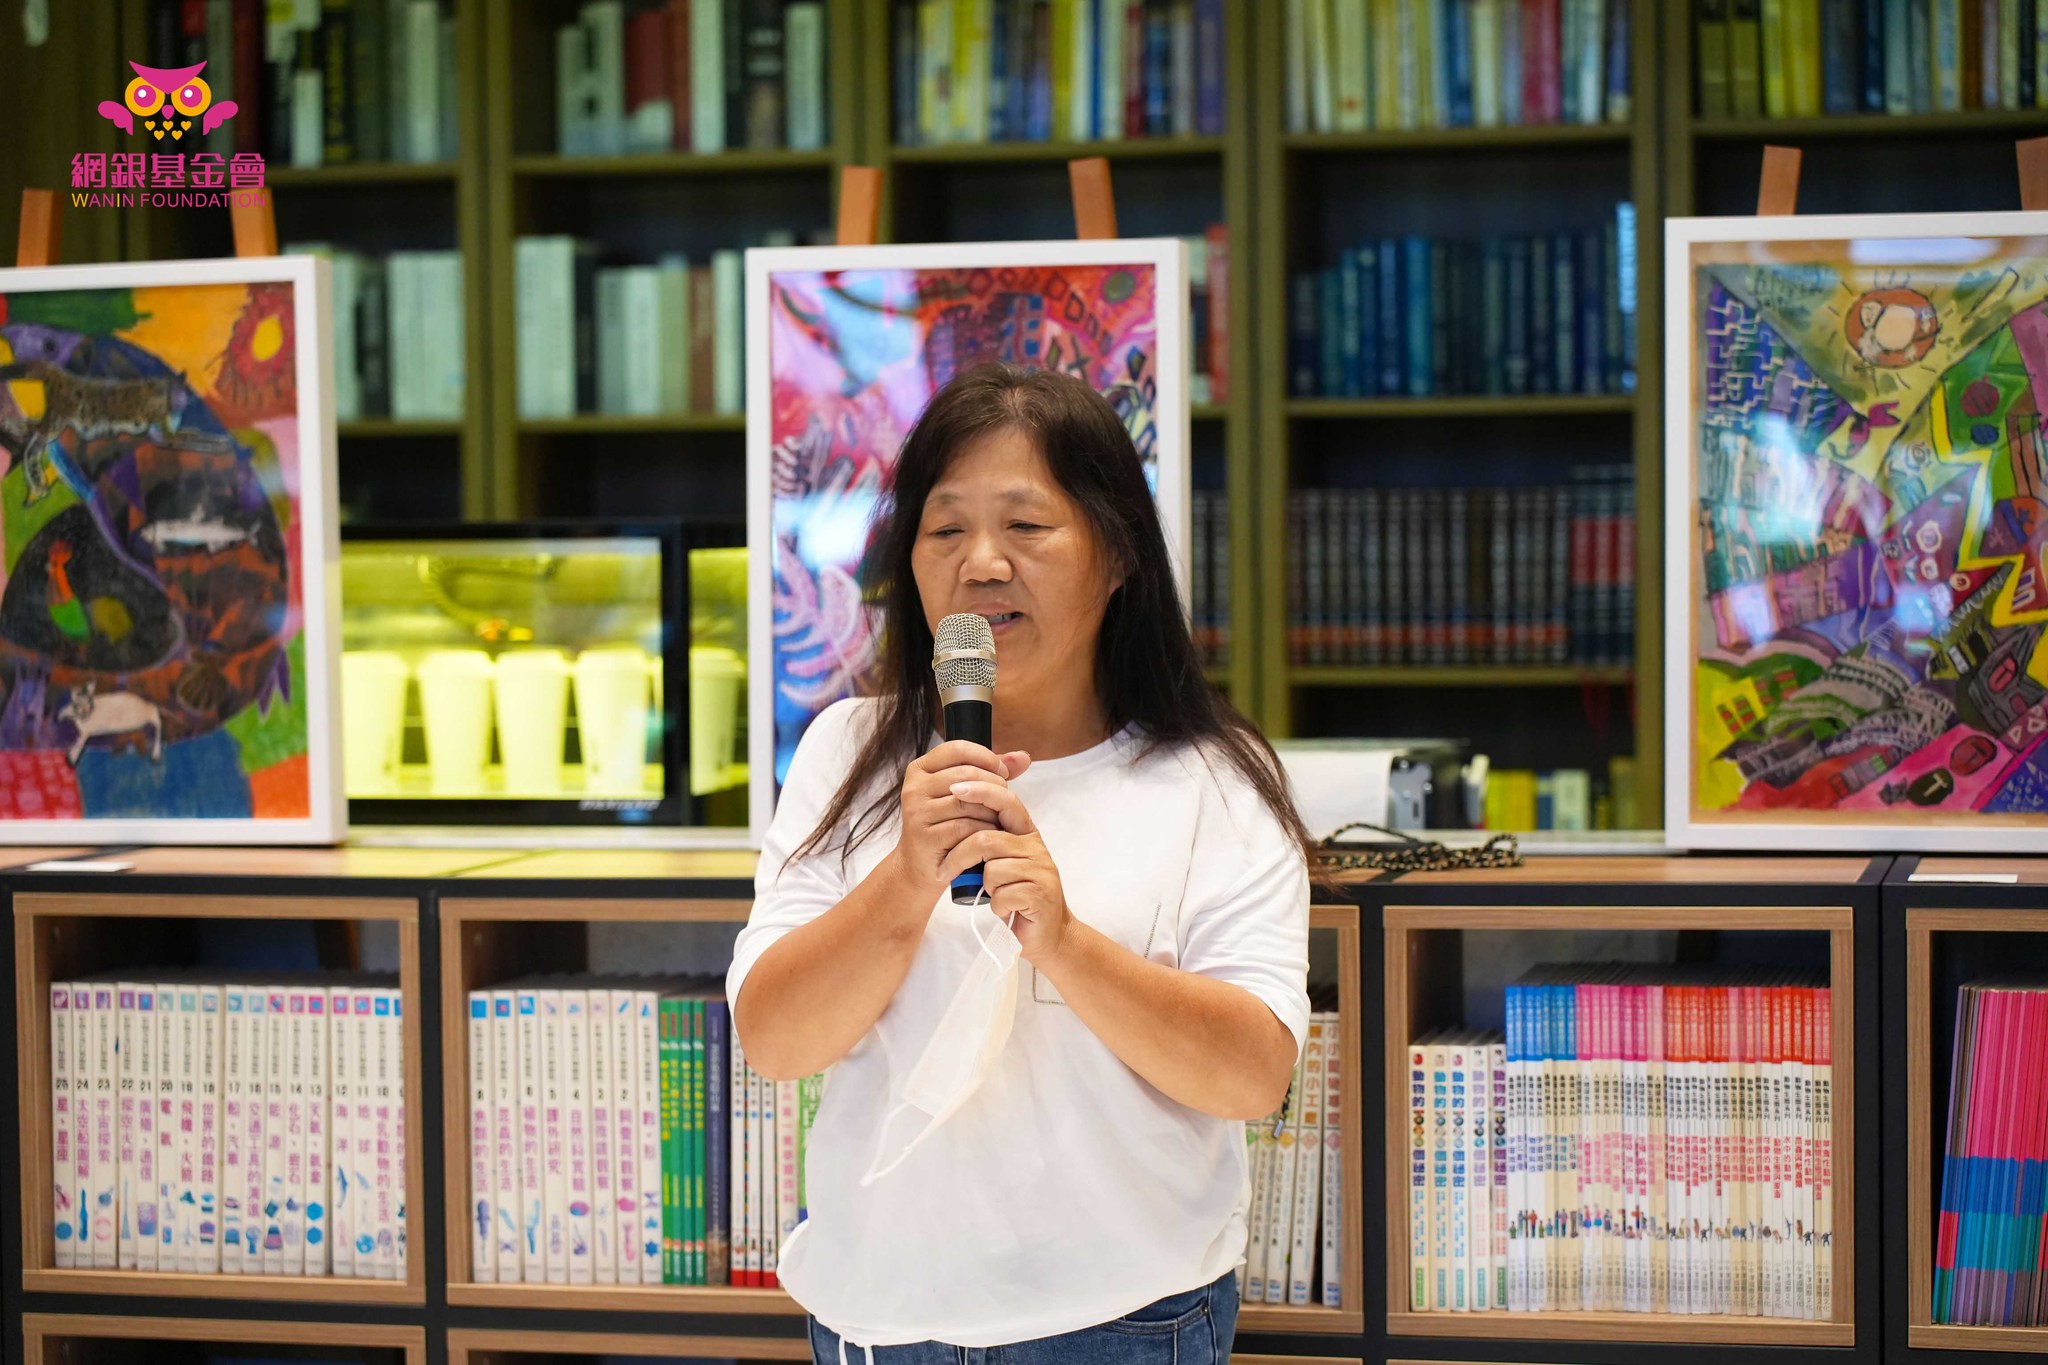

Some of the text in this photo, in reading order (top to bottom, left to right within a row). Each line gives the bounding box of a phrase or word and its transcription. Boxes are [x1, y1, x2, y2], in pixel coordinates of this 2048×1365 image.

[77, 1079, 88, 1090] 24
[98, 1079, 110, 1090] 23
[121, 1079, 134, 1089] 22
[140, 1080, 151, 1092] 21
[161, 1080, 173, 1092] 20
[229, 1083, 240, 1094] 17
[290, 1085, 302, 1095] 14
[336, 1086, 347, 1096] 12
[358, 1086, 368, 1096] 11
[98, 1098, 110, 1162] 宇宙探索
